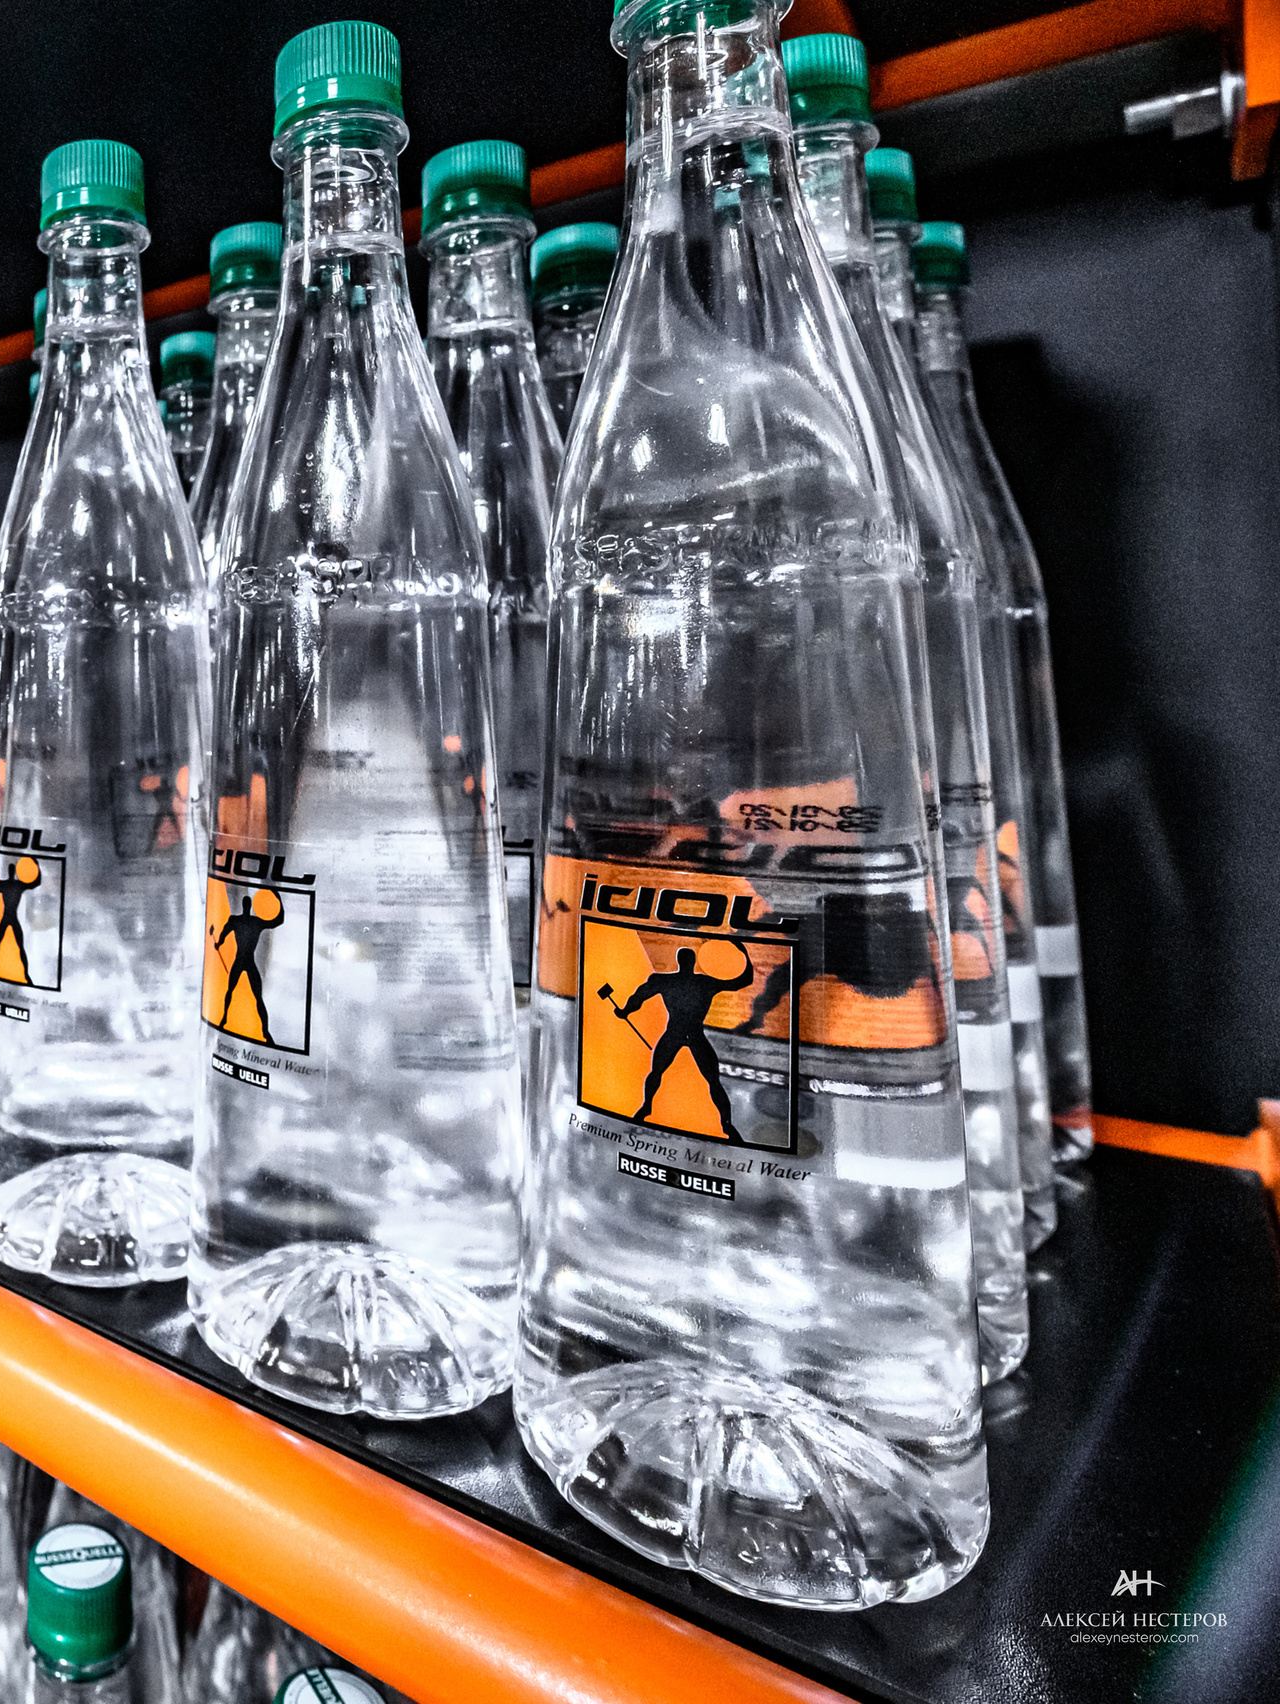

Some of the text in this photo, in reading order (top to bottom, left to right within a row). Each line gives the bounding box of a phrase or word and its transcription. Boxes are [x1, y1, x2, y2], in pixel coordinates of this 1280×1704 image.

[241, 1048, 282, 1070] Mineral
[568, 1112, 812, 1182] Premium Spring Mineral Water
